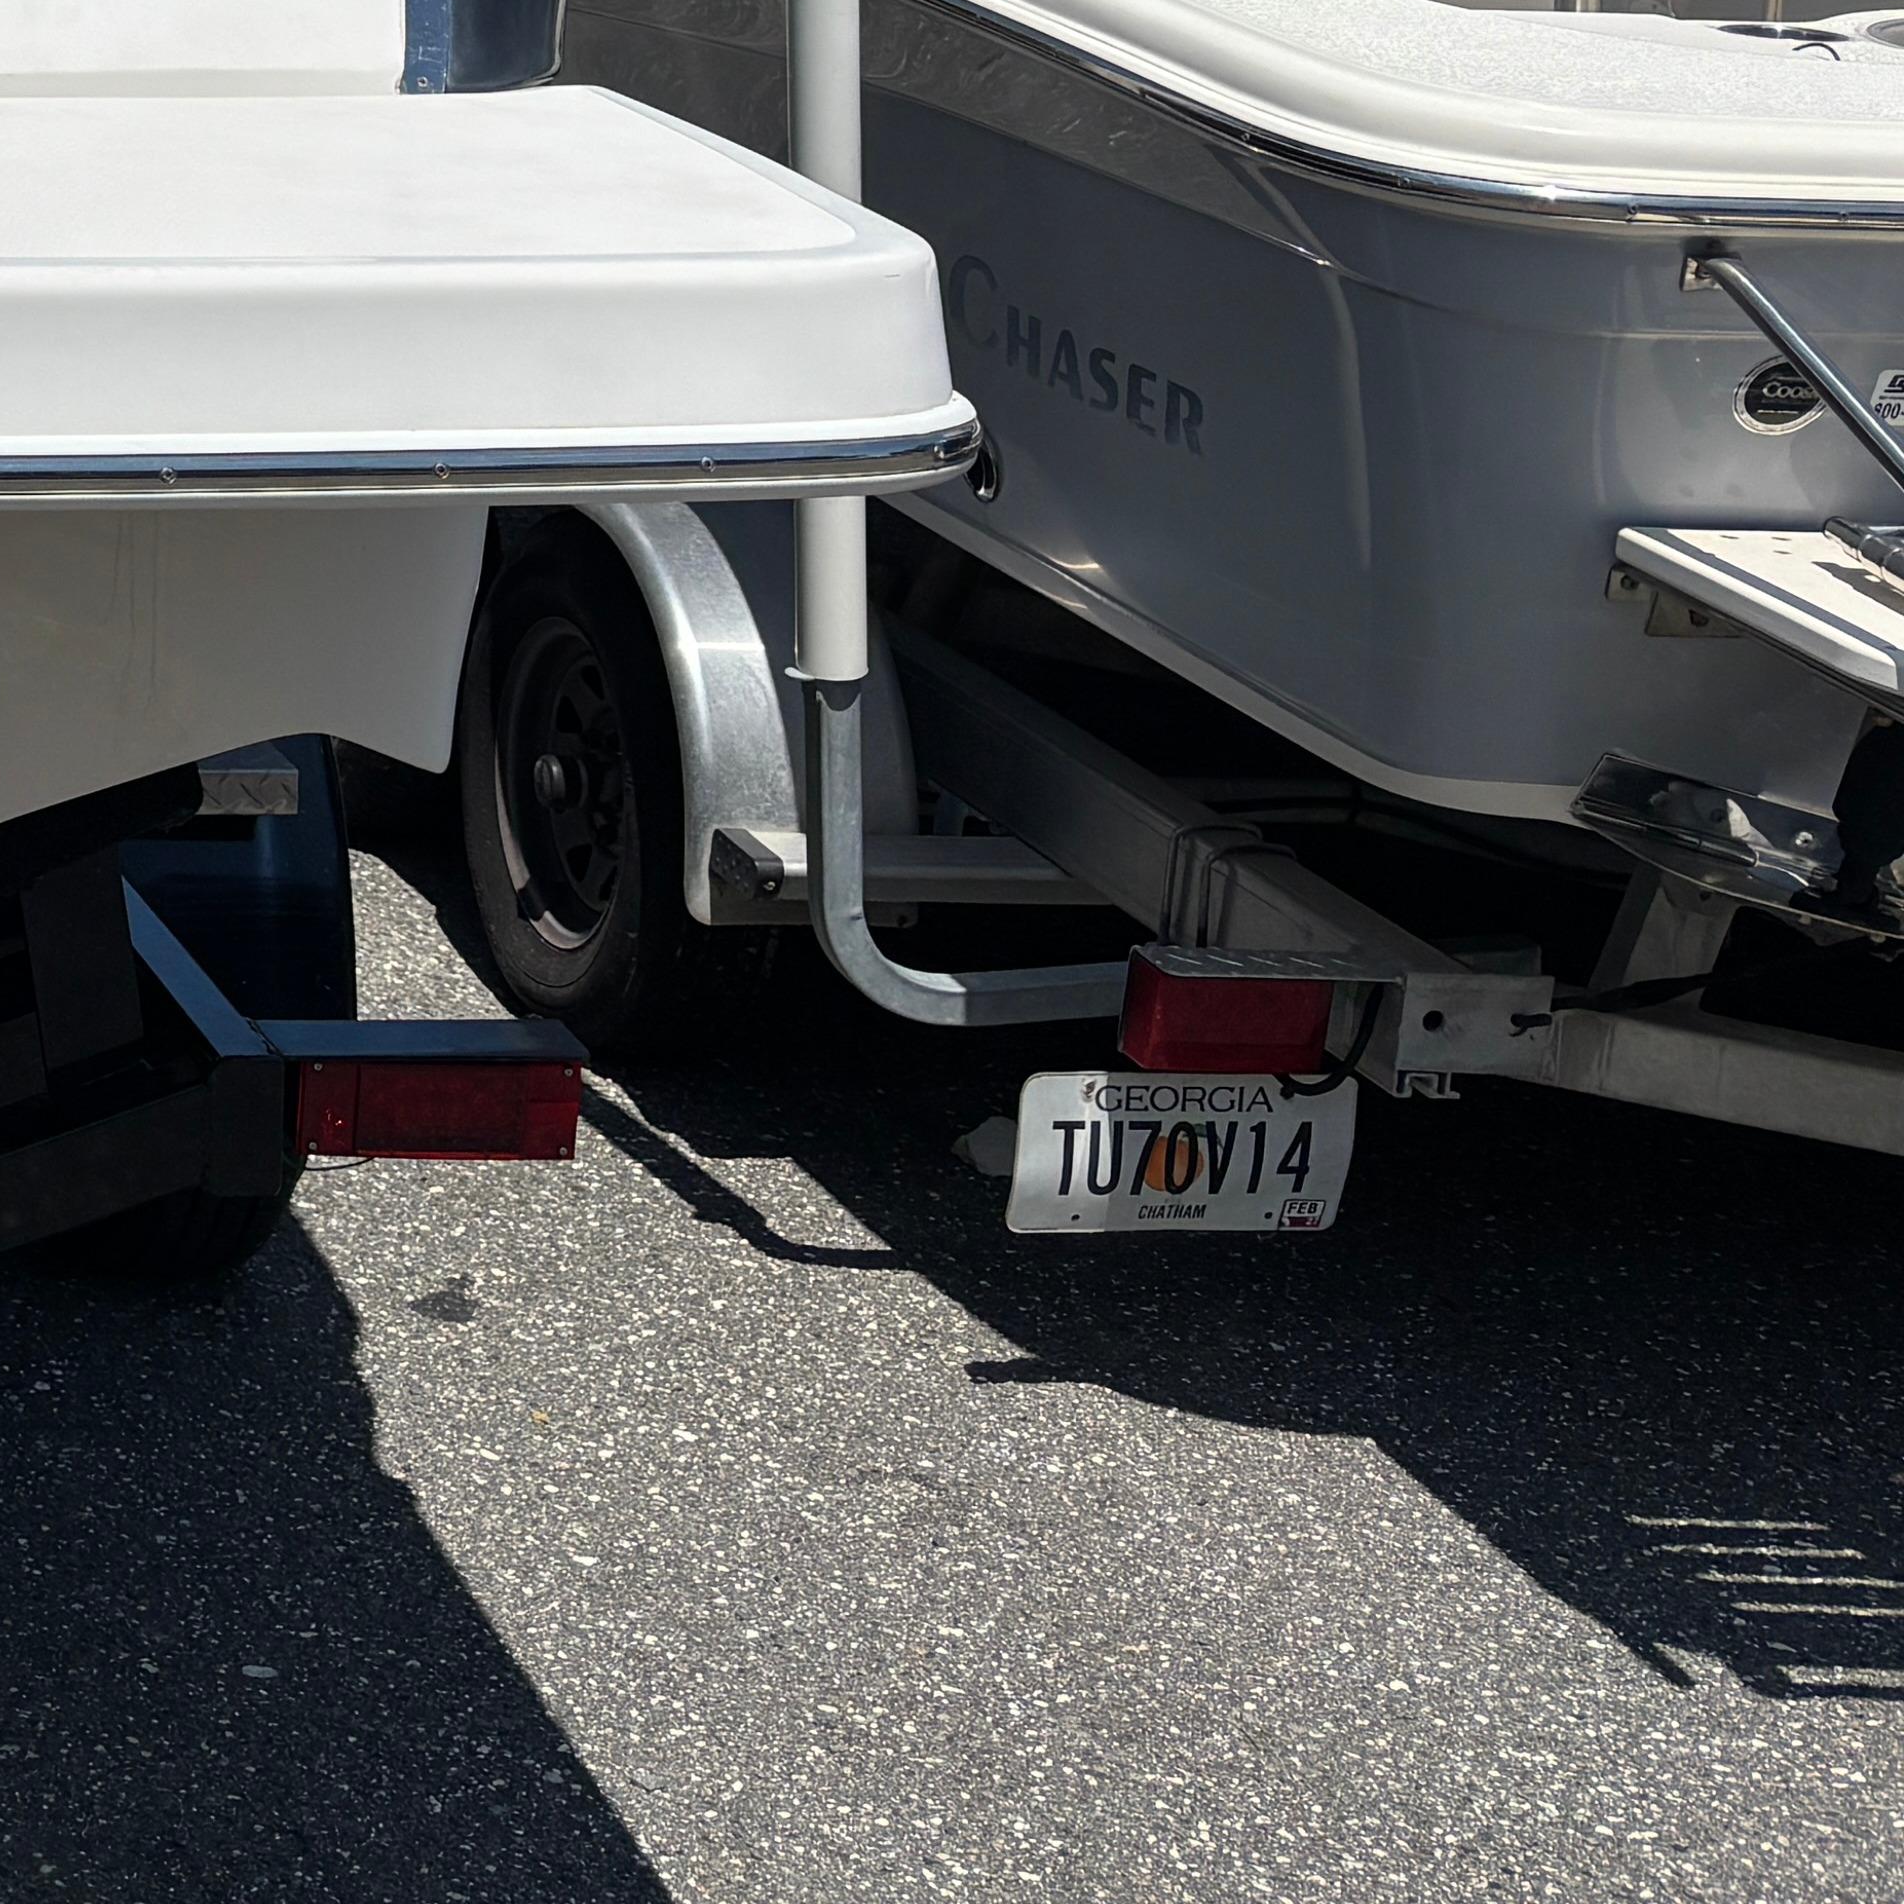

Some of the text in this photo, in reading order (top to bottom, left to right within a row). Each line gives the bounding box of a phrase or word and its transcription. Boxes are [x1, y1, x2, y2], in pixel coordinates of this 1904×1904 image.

[949, 253, 1204, 457] CHASER
[1094, 1085, 1274, 1113] GEORGIA
[1052, 1120, 1314, 1196] TU70V14
[1138, 1203, 1207, 1220] CHATHAM
[1287, 1201, 1318, 1214] FEB
